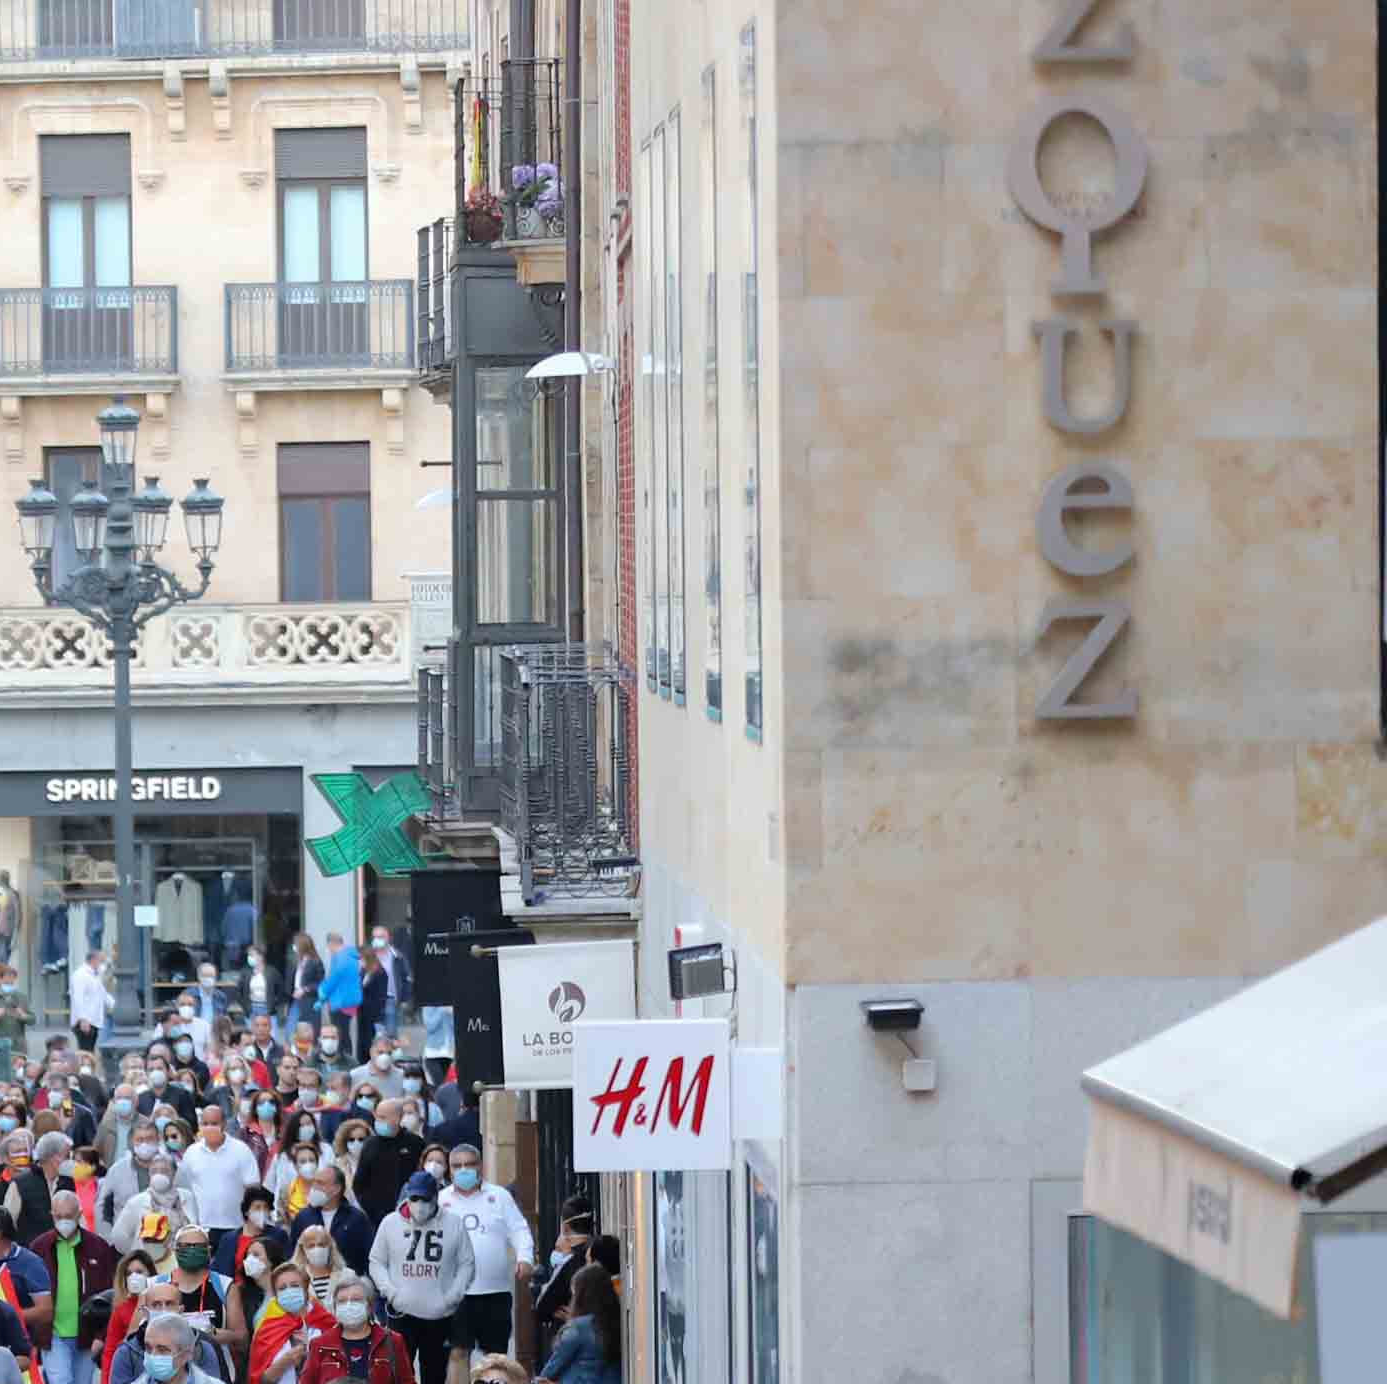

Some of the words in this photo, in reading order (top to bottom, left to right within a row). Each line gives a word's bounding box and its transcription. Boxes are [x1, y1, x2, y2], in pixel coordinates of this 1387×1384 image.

[522, 1031, 545, 1046] LA
[589, 1055, 715, 1136] H&M
[405, 1230, 443, 1262] 76
[402, 1263, 441, 1278] GLORY
